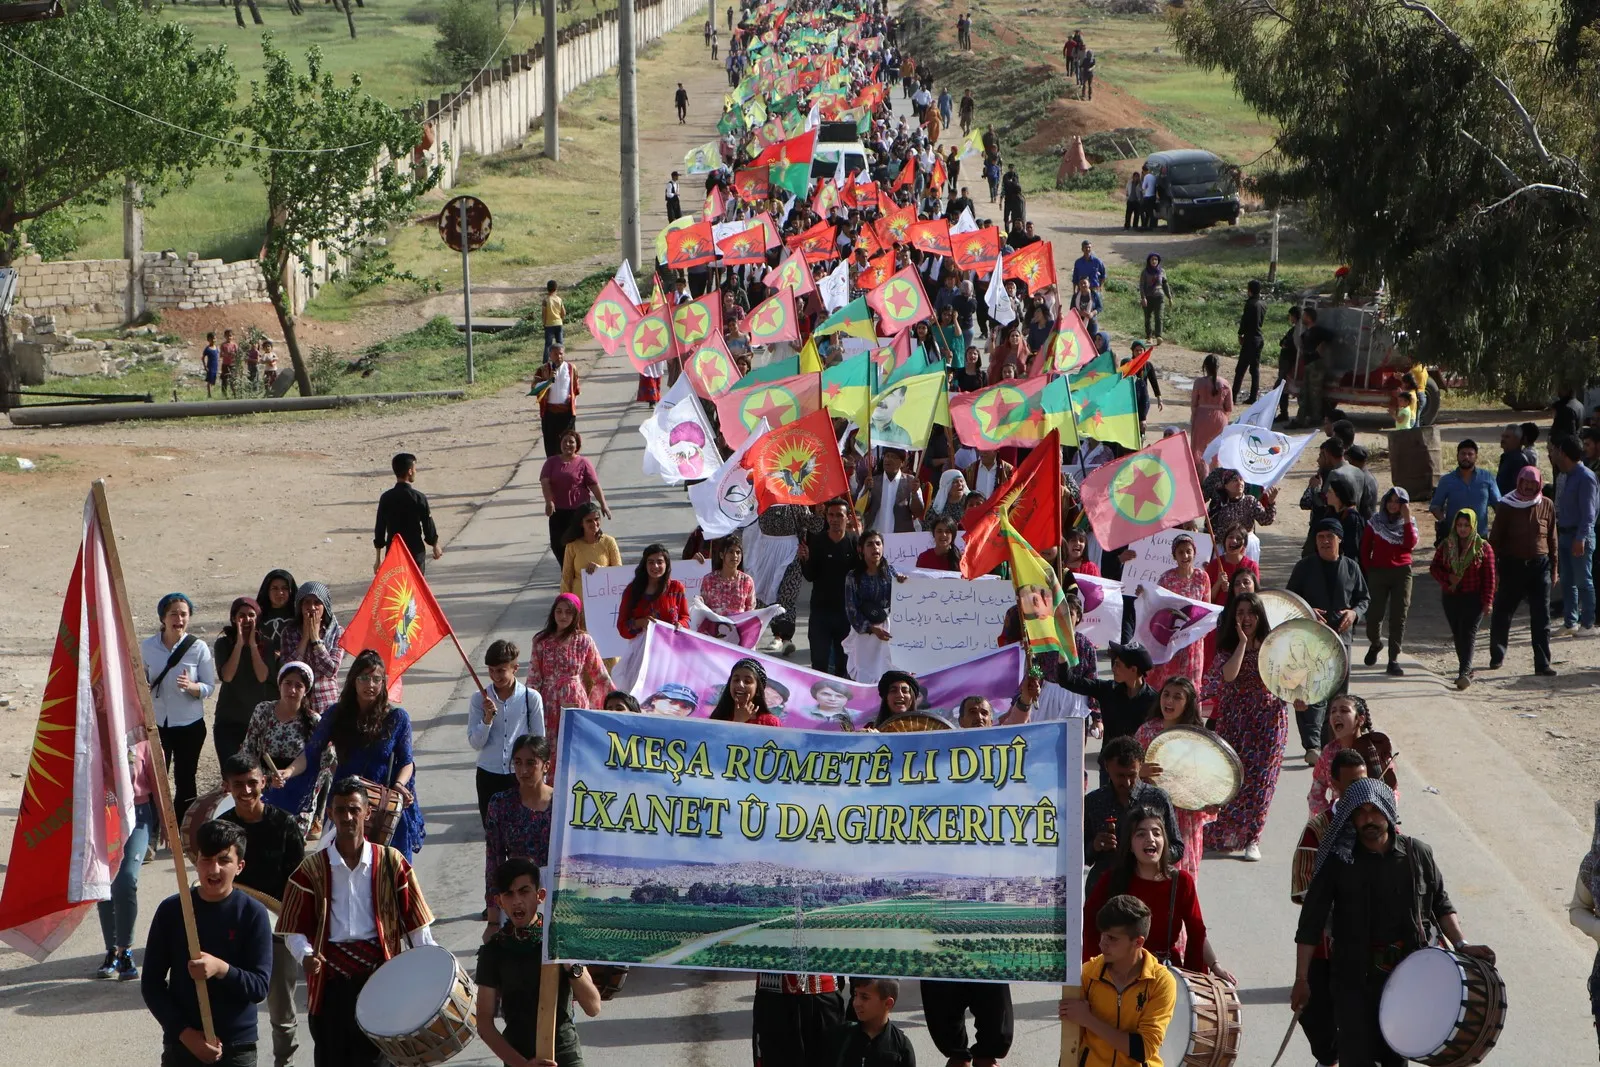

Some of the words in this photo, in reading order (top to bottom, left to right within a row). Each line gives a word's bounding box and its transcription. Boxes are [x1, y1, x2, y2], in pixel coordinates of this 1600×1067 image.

[605, 731, 714, 785] MEŞA
[721, 739, 893, 787] RÛMETÊ
[899, 748, 939, 785] LI
[948, 734, 1028, 789] DIJÎ
[569, 779, 730, 837] ÎXANET
[738, 792, 769, 840] Û
[775, 795, 1059, 847] DAGIRKERIYÊ
